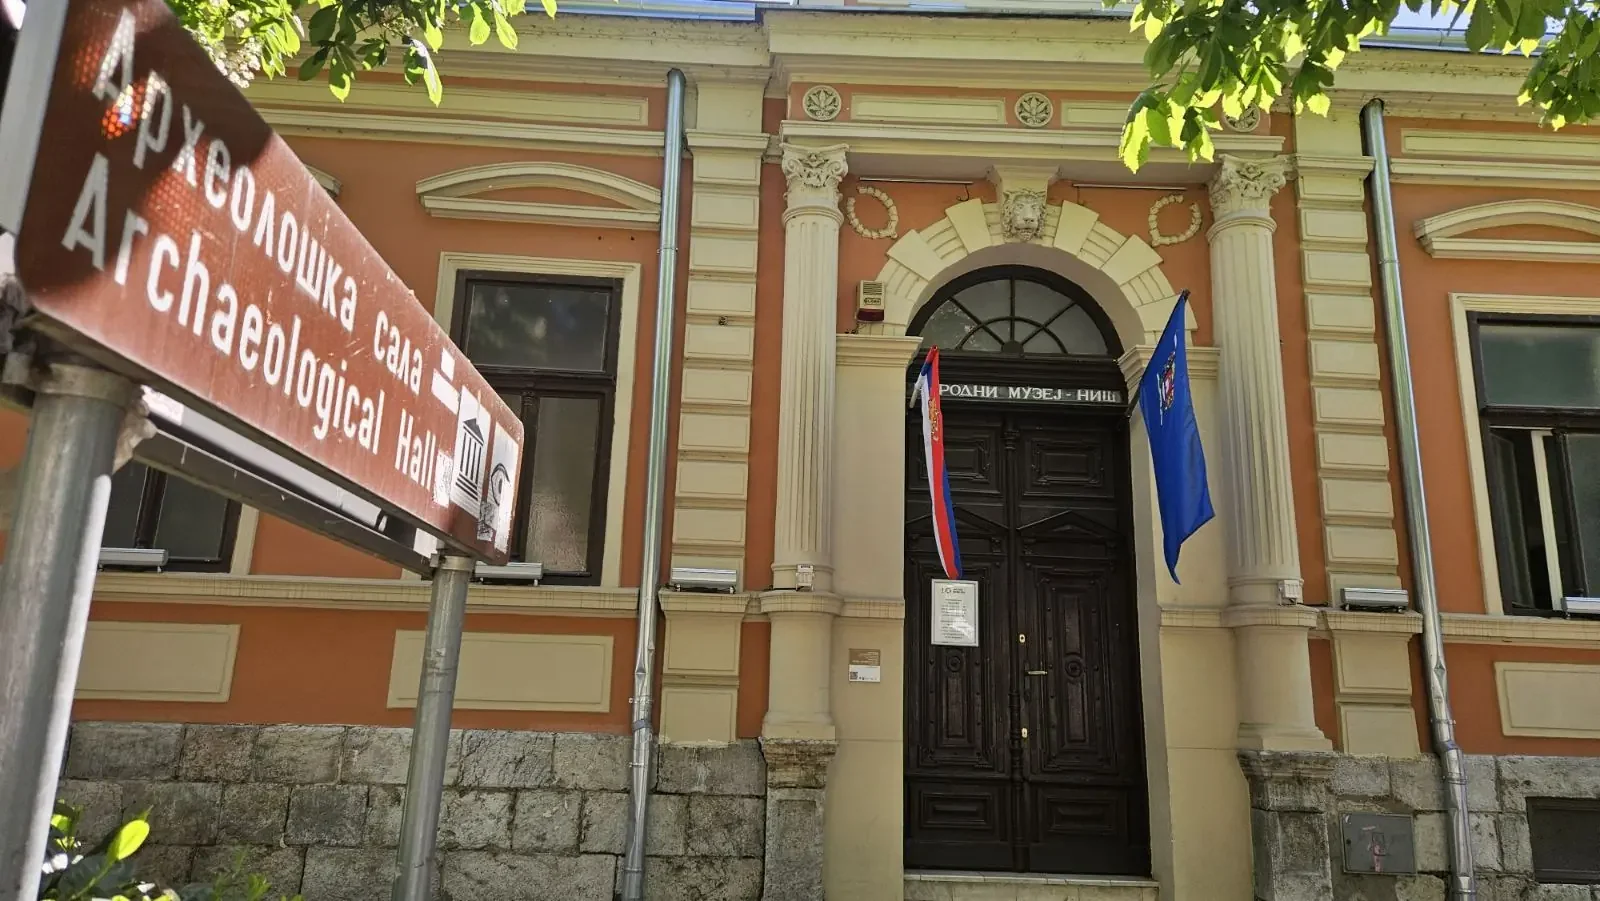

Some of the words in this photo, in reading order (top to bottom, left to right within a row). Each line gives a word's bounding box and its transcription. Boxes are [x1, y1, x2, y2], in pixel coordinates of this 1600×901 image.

[61, 152, 386, 455] Archaeological
[395, 408, 437, 492] Hall
[92, 7, 358, 332] Археолошка
[374, 310, 423, 396] сала
[939, 383, 998, 398] РОДНИ
[1008, 386, 1062, 400] МУЗЕЈ
[1077, 388, 1116, 402] НИШ
